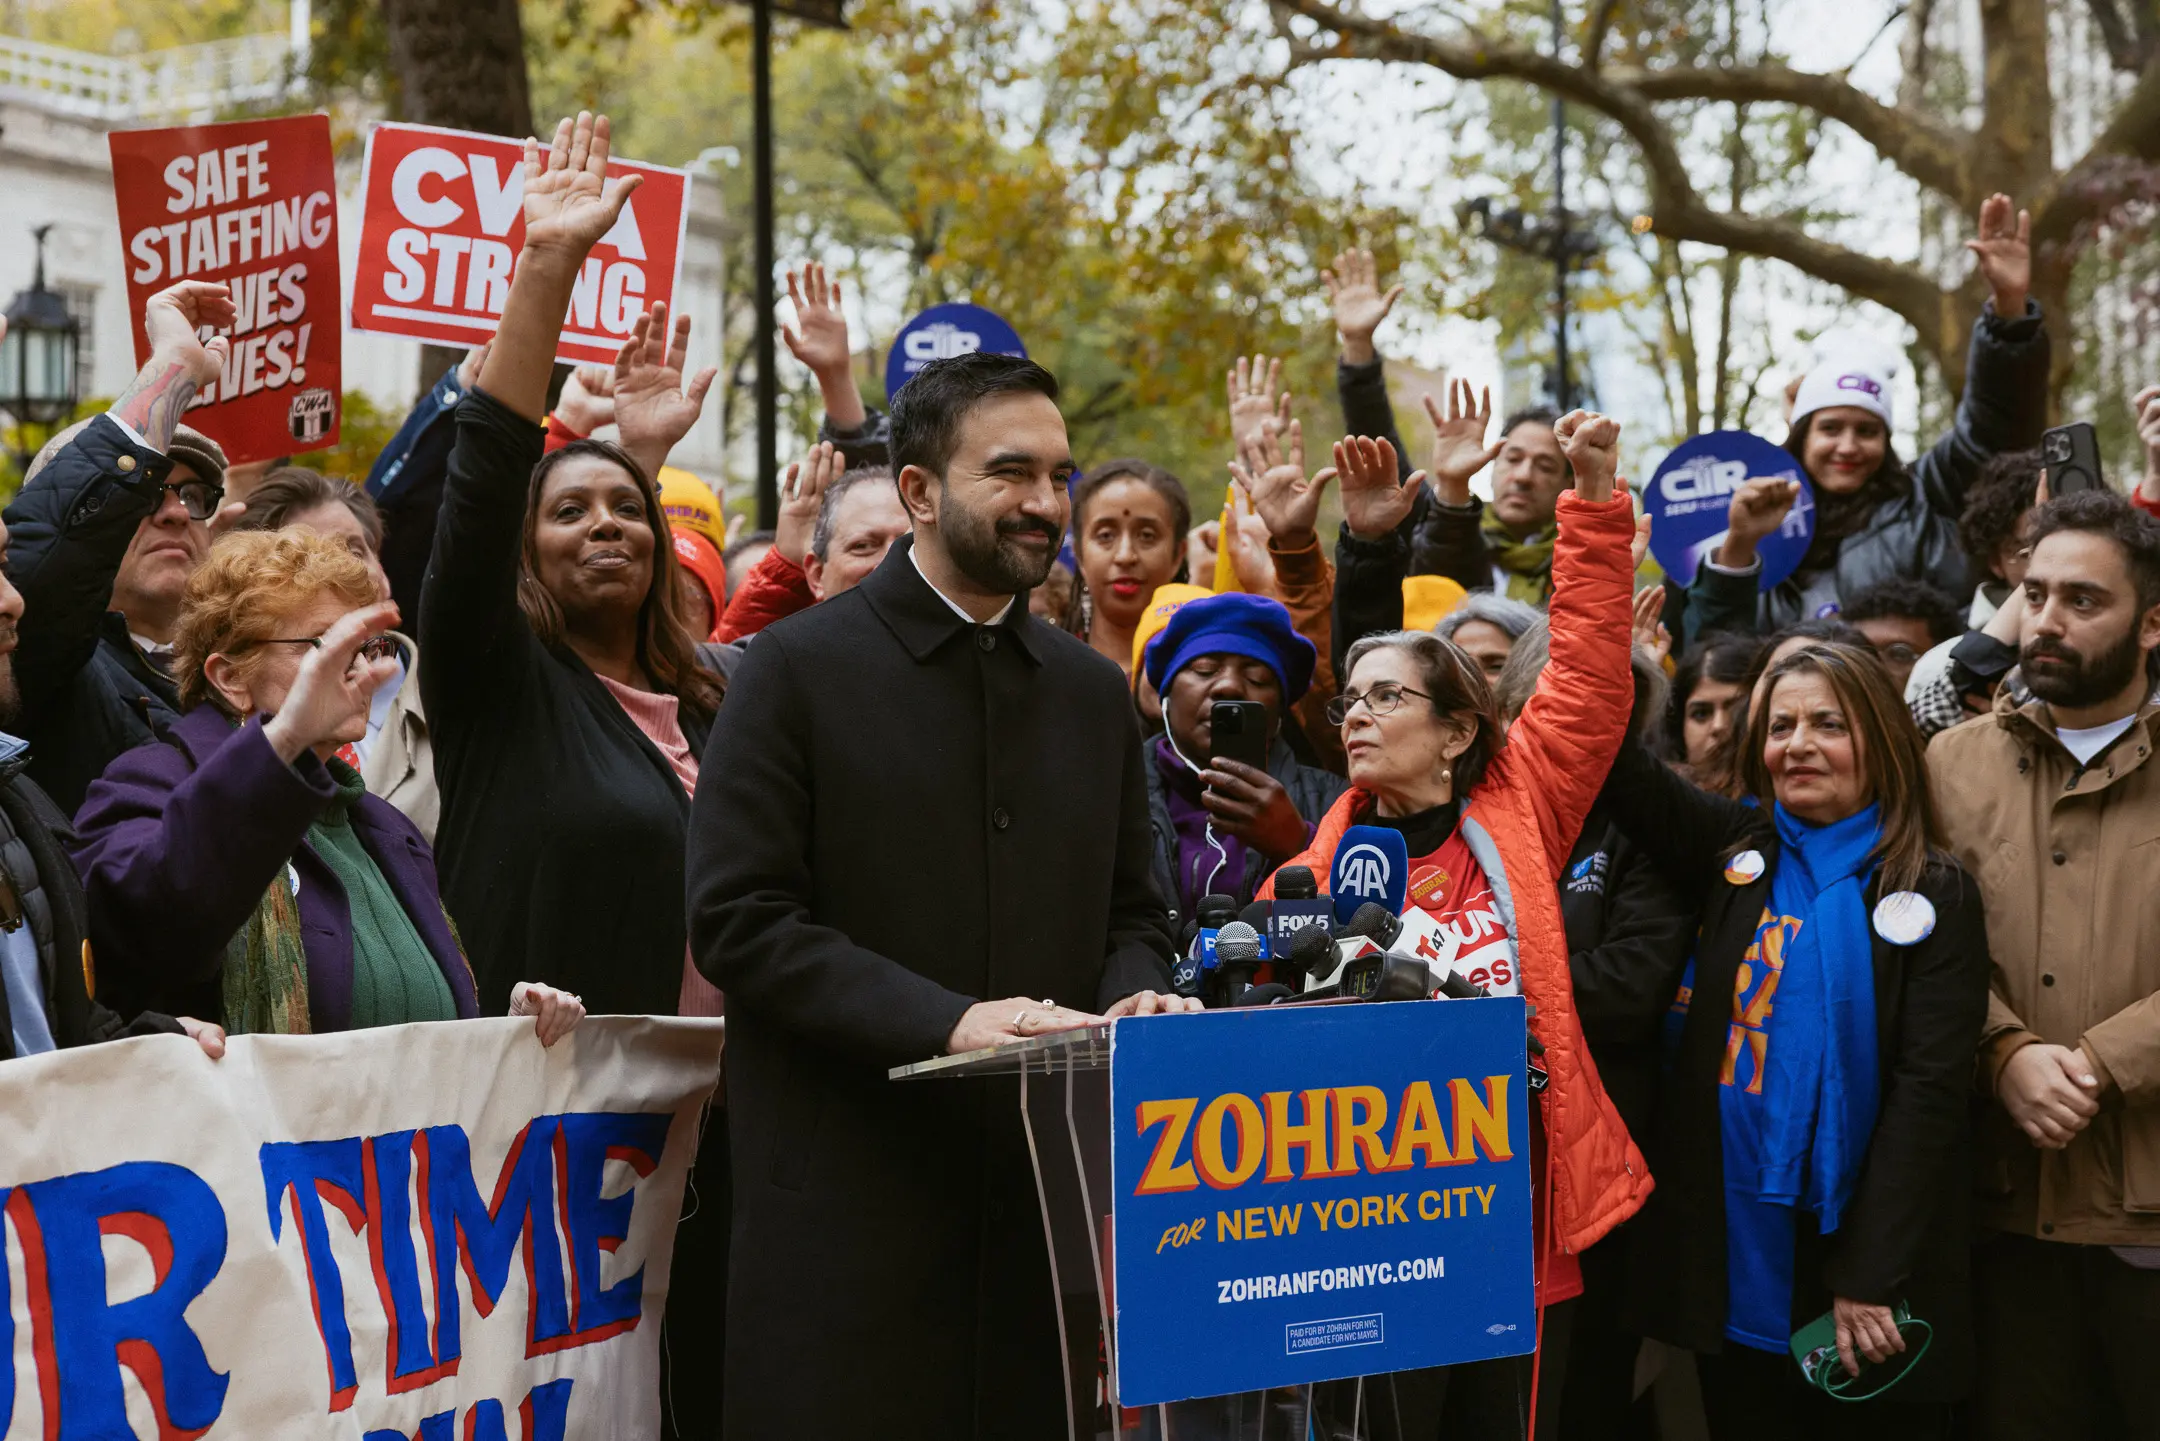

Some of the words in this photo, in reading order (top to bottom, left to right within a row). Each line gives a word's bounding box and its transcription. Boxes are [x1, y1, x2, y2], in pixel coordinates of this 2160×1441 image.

[163, 139, 270, 214] SAFE
[130, 190, 332, 285] STAFFING
[197, 262, 308, 343] VES
[383, 228, 647, 334] STRNG
[184, 322, 312, 412] VES!
[295, 394, 329, 413] CWA
[1338, 858, 1388, 899] AA
[1412, 872, 1448, 899] ZOHRAN
[1279, 915, 1314, 932] FOX
[1316, 915, 1329, 931] 5
[1431, 929, 1445, 950] 47
[1174, 966, 1197, 987] ab
[1461, 959, 1512, 986] es
[1133, 1074, 1515, 1196] ZOHRAN
[1156, 1217, 1206, 1254] FOR
[1217, 1204, 1303, 1243] NEW
[1312, 1192, 1410, 1232] YORK
[1418, 1184, 1497, 1221] CITY
[259, 1112, 675, 1414] TIME
[1218, 1256, 1445, 1304] ZOHRANFORNYC.COM
[1290, 1328, 1304, 1338] PAID
[1305, 1327, 1317, 1336] FOR
[1318, 1326, 1325, 1335] BY
[1327, 1322, 1351, 1334] ZOHRAN
[1352, 1321, 1364, 1330] FOR
[1292, 1340, 1297, 1349] A
[1298, 1335, 1331, 1348] CANDIDATE
[1332, 1334, 1343, 1343] FOR
[1344, 1332, 1357, 1342] NYC
[1357, 1329, 1378, 1340] MAYOR
